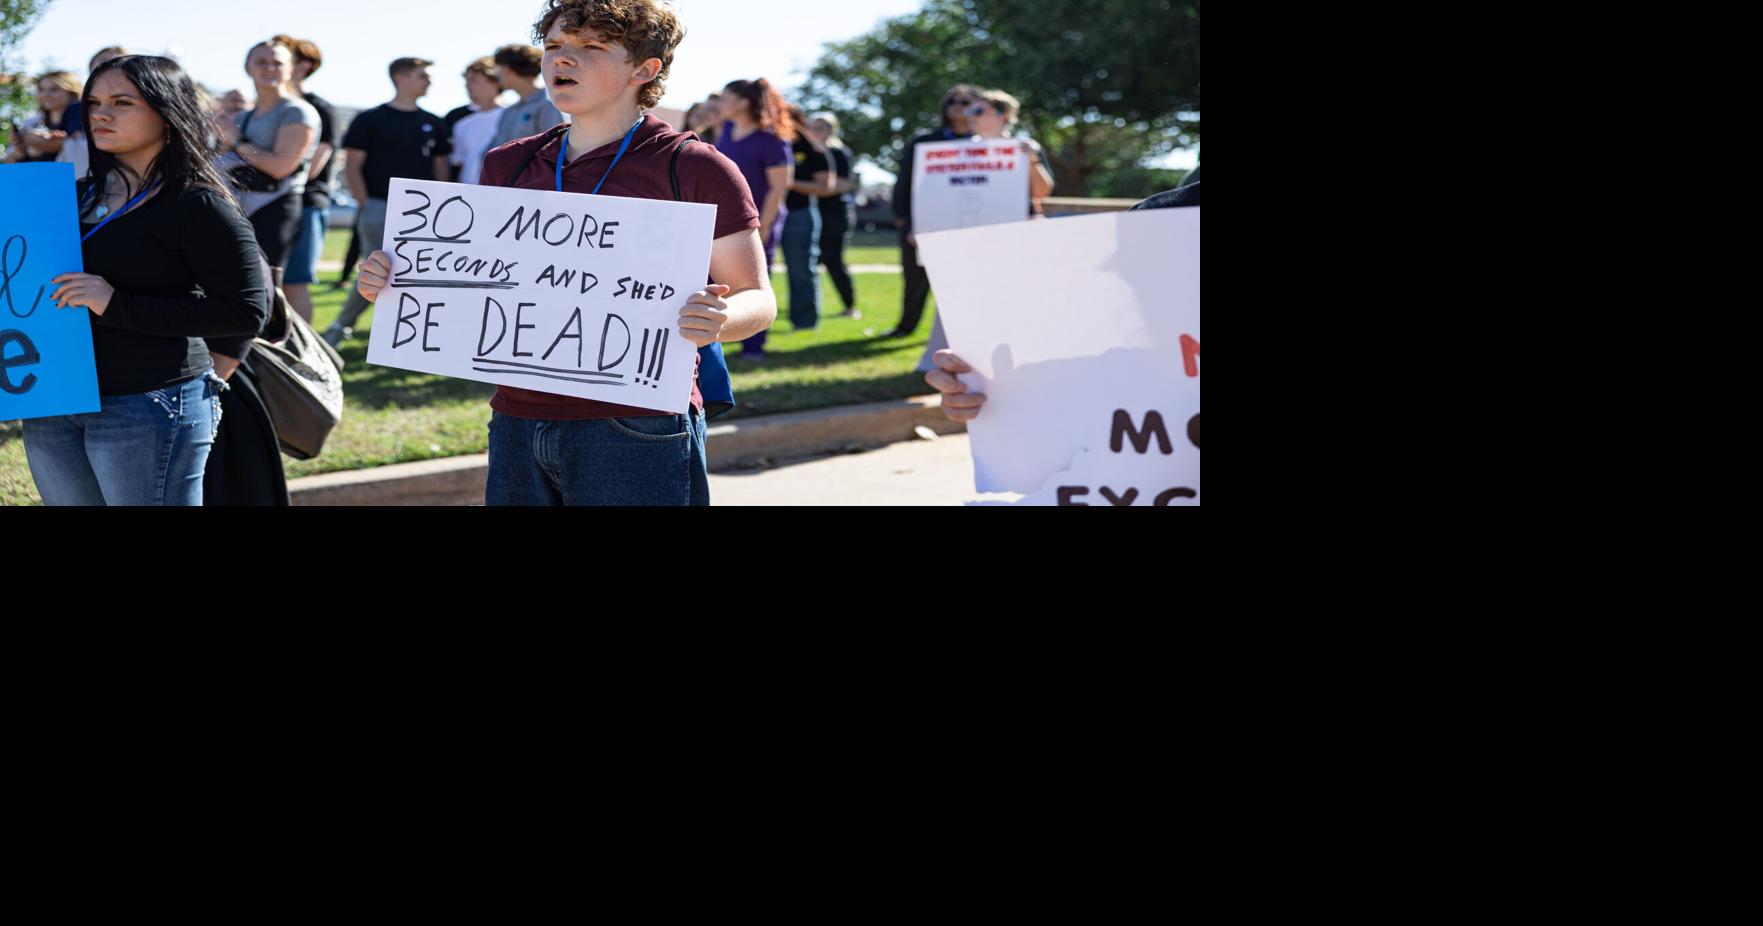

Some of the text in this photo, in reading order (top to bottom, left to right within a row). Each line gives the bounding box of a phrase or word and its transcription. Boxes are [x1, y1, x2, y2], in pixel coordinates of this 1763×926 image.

[398, 189, 620, 249] 30 MORE
[394, 240, 675, 301] SECONDS AND SHE'D
[391, 292, 670, 389] BE DEAD!!!
